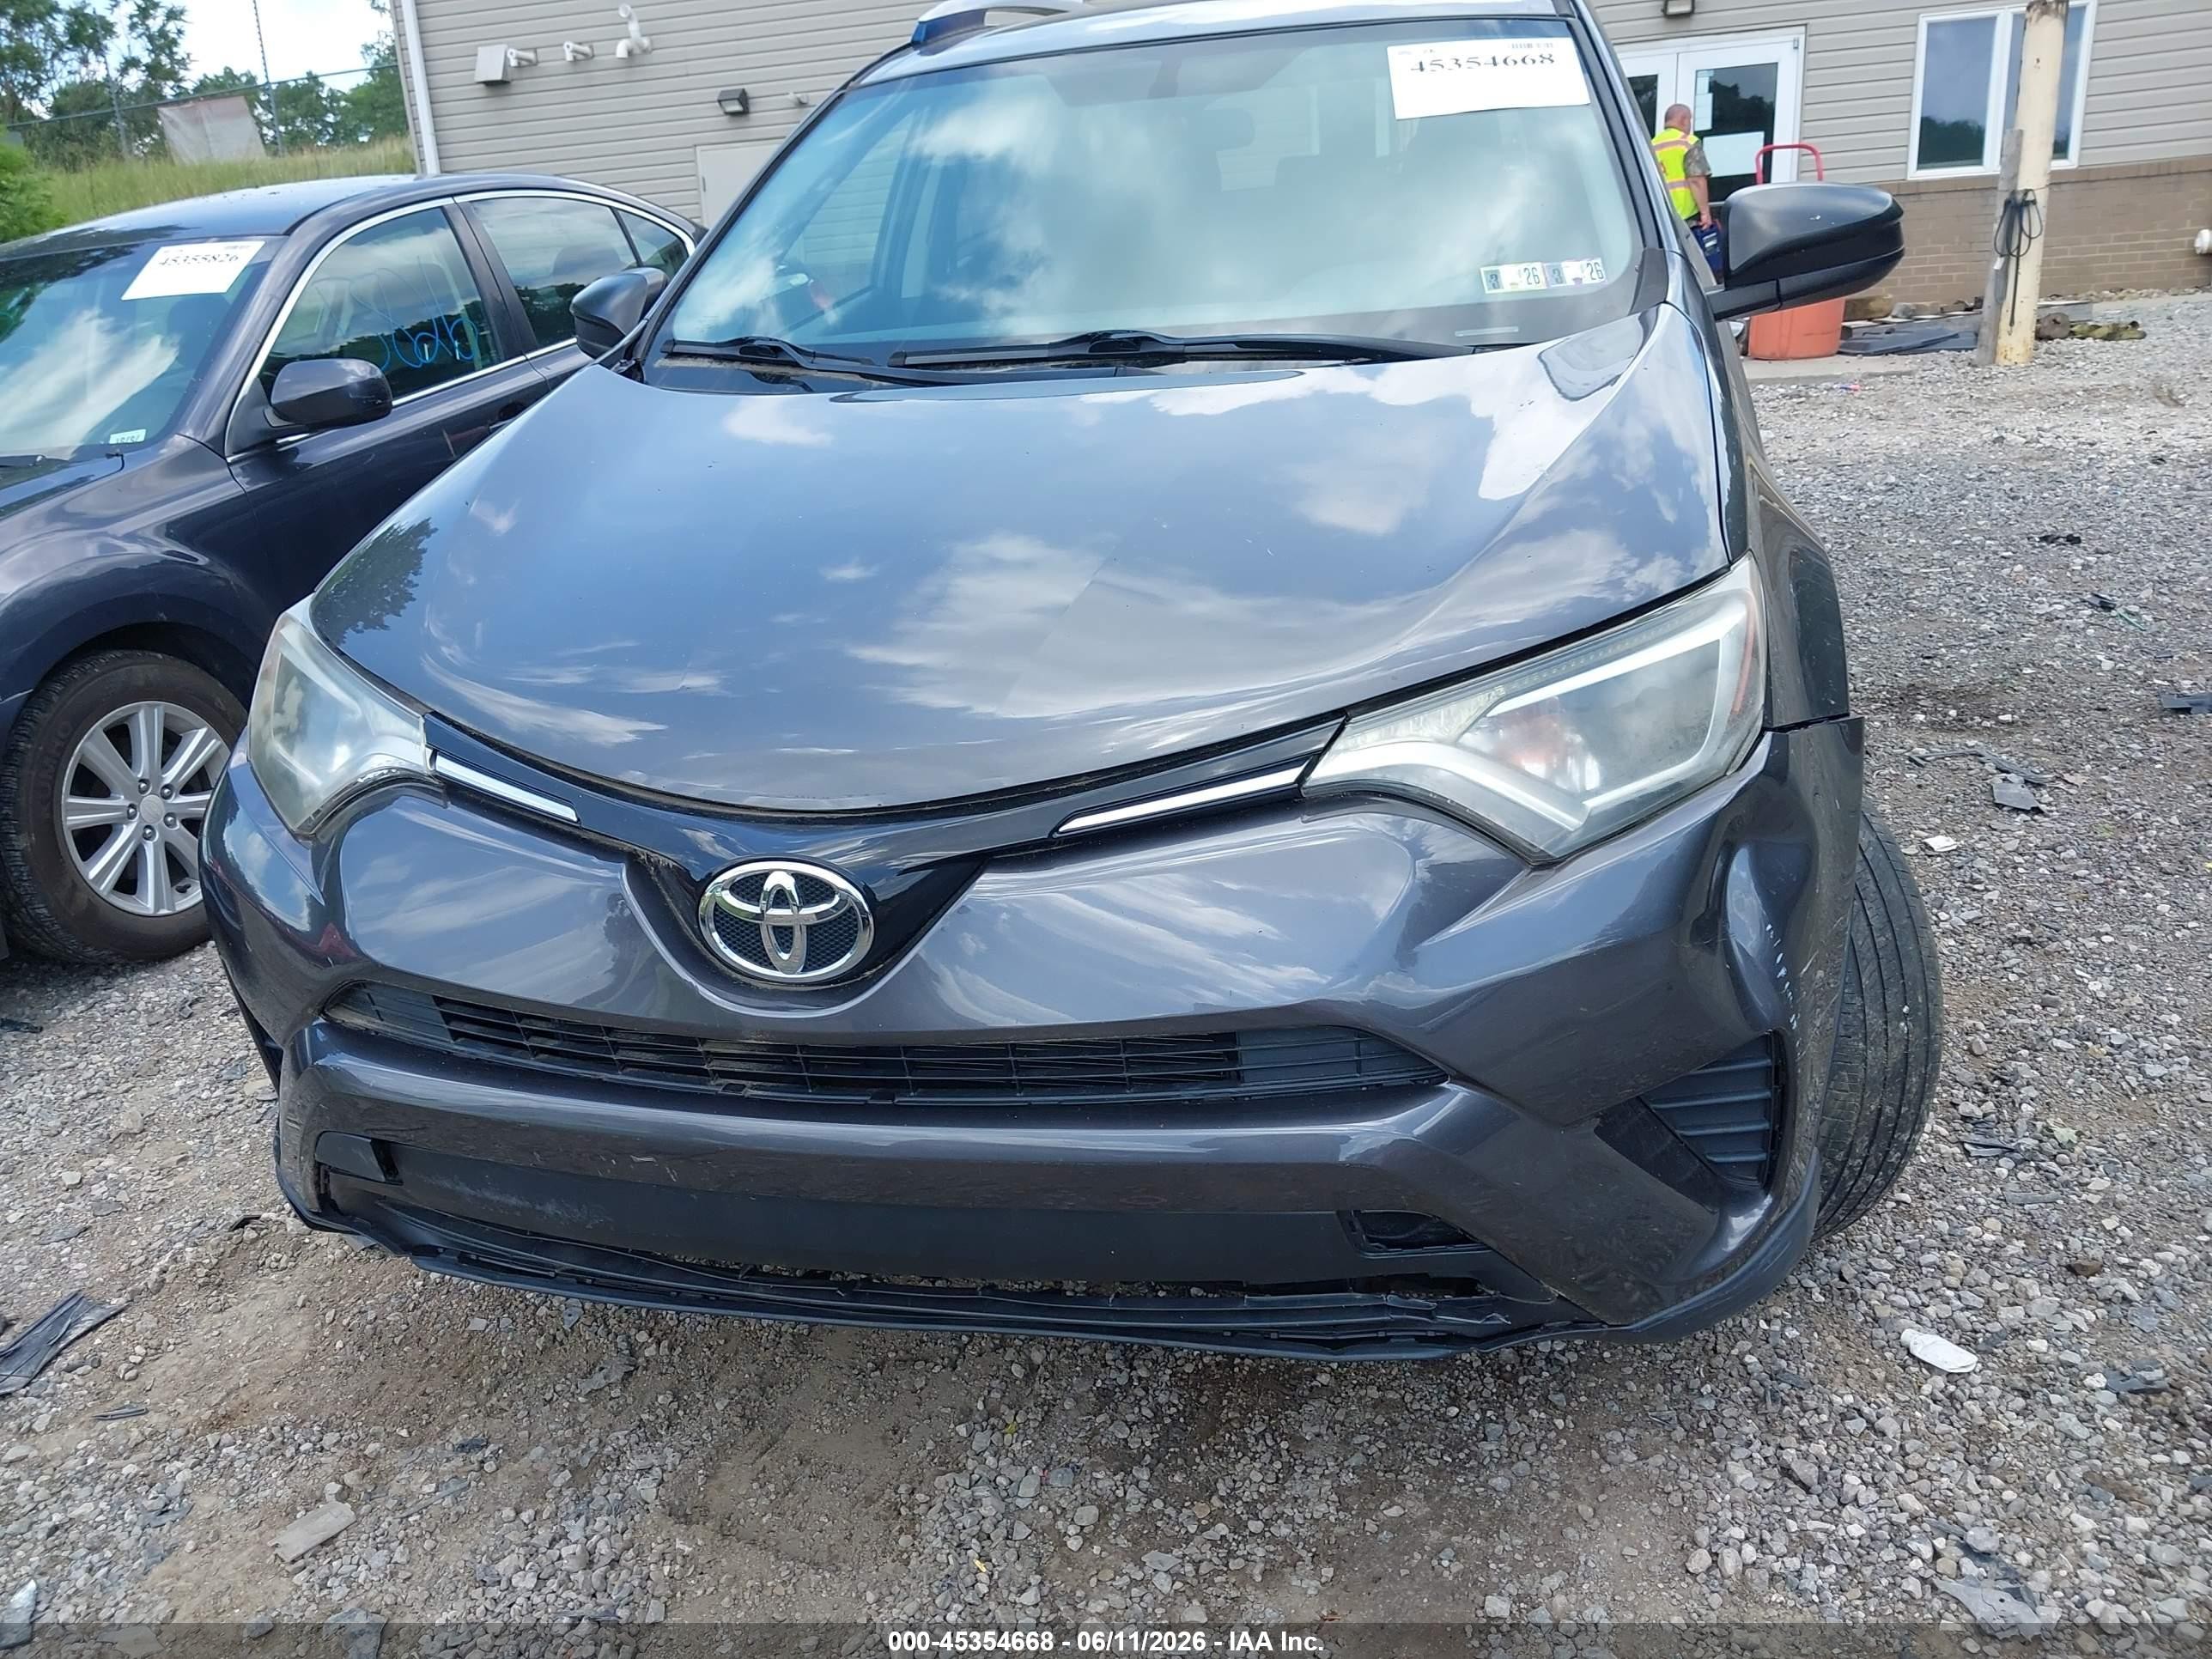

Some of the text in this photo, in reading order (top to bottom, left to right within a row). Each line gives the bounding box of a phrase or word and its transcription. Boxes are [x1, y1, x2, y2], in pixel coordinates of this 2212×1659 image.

[1411, 52, 1555, 72] 45354668
[1523, 267, 1540, 285] 26
[1552, 261, 1604, 285] 3 26
